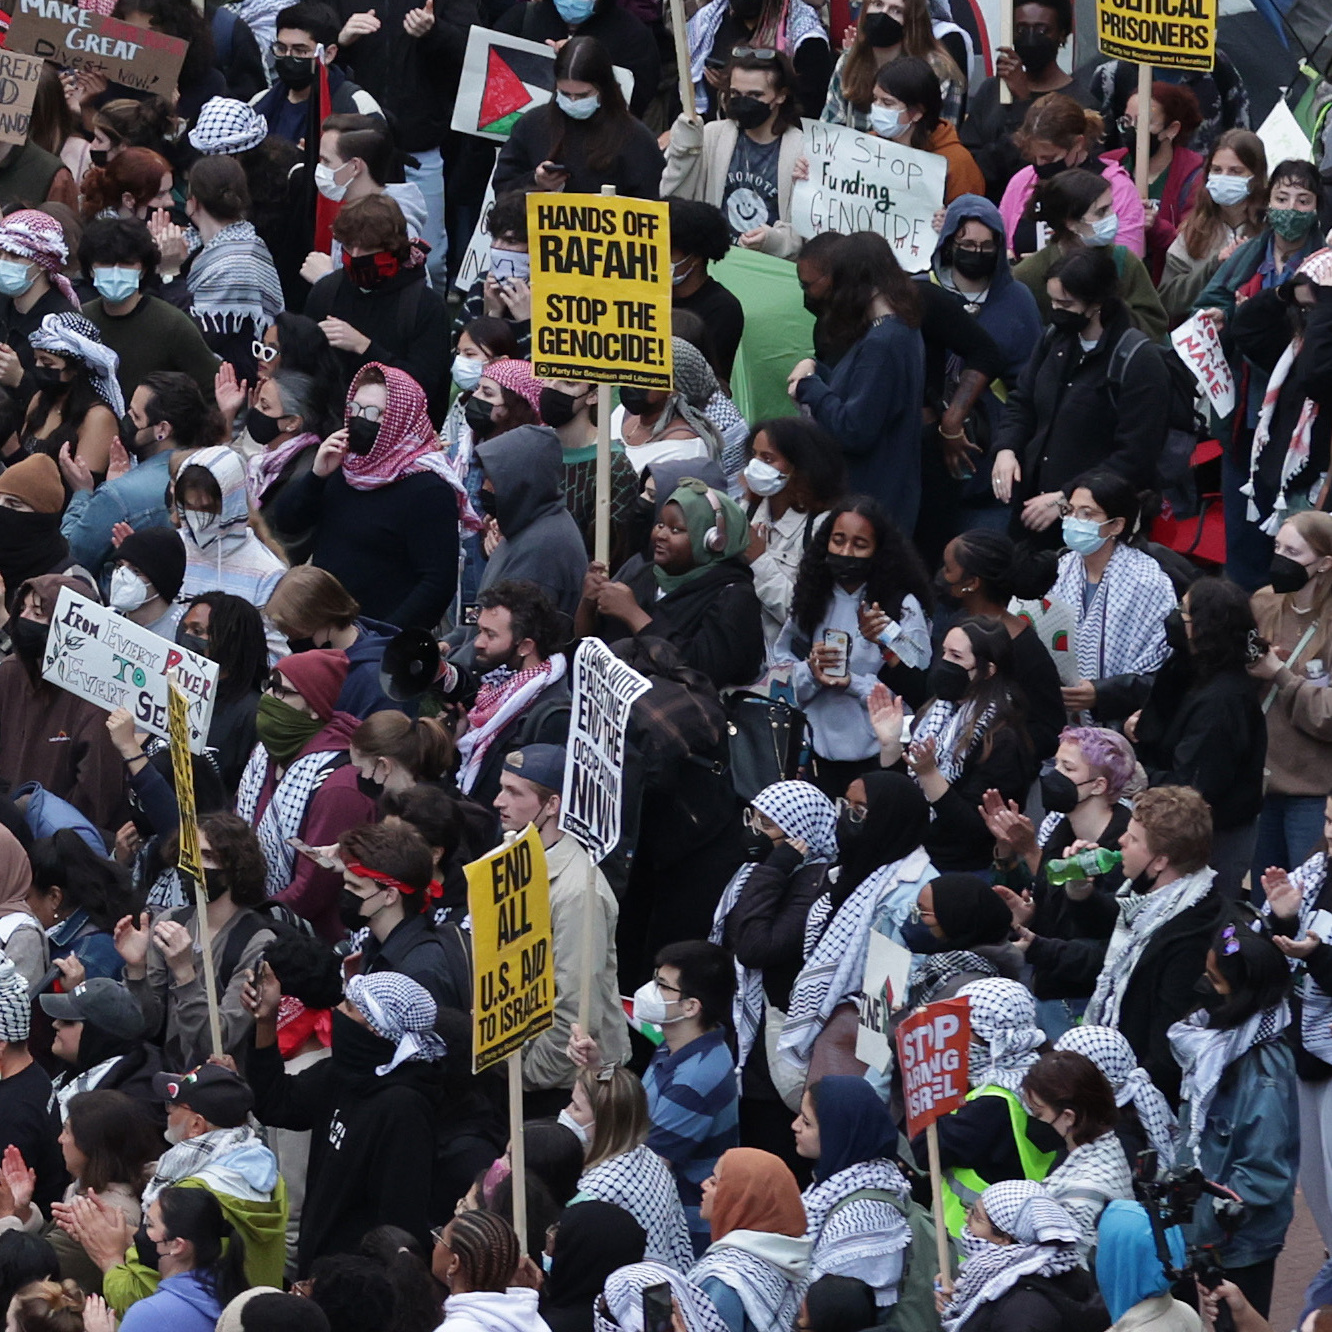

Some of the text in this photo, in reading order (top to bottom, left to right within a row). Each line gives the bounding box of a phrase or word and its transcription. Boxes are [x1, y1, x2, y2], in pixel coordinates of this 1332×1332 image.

[64, 28, 145, 61] GREAT
[1101, 9, 1209, 50] PRISONERS
[822, 161, 896, 213] Funding
[537, 204, 660, 241] HANDS OFF
[539, 235, 659, 284] RAFAH!
[546, 293, 657, 332] STOP THE
[538, 326, 665, 367] GENOCIDE!
[551, 367, 669, 386] Party Socialism Liberation
[60, 600, 162, 670] FROM EVERY
[65, 654, 130, 710] EVERY
[112, 656, 147, 687] TO
[491, 838, 532, 905] END
[496, 890, 534, 952] ALL
[480, 938, 547, 1013] U.S. AID
[478, 1011, 498, 1048] TO
[499, 977, 549, 1038] ISRAEL!
